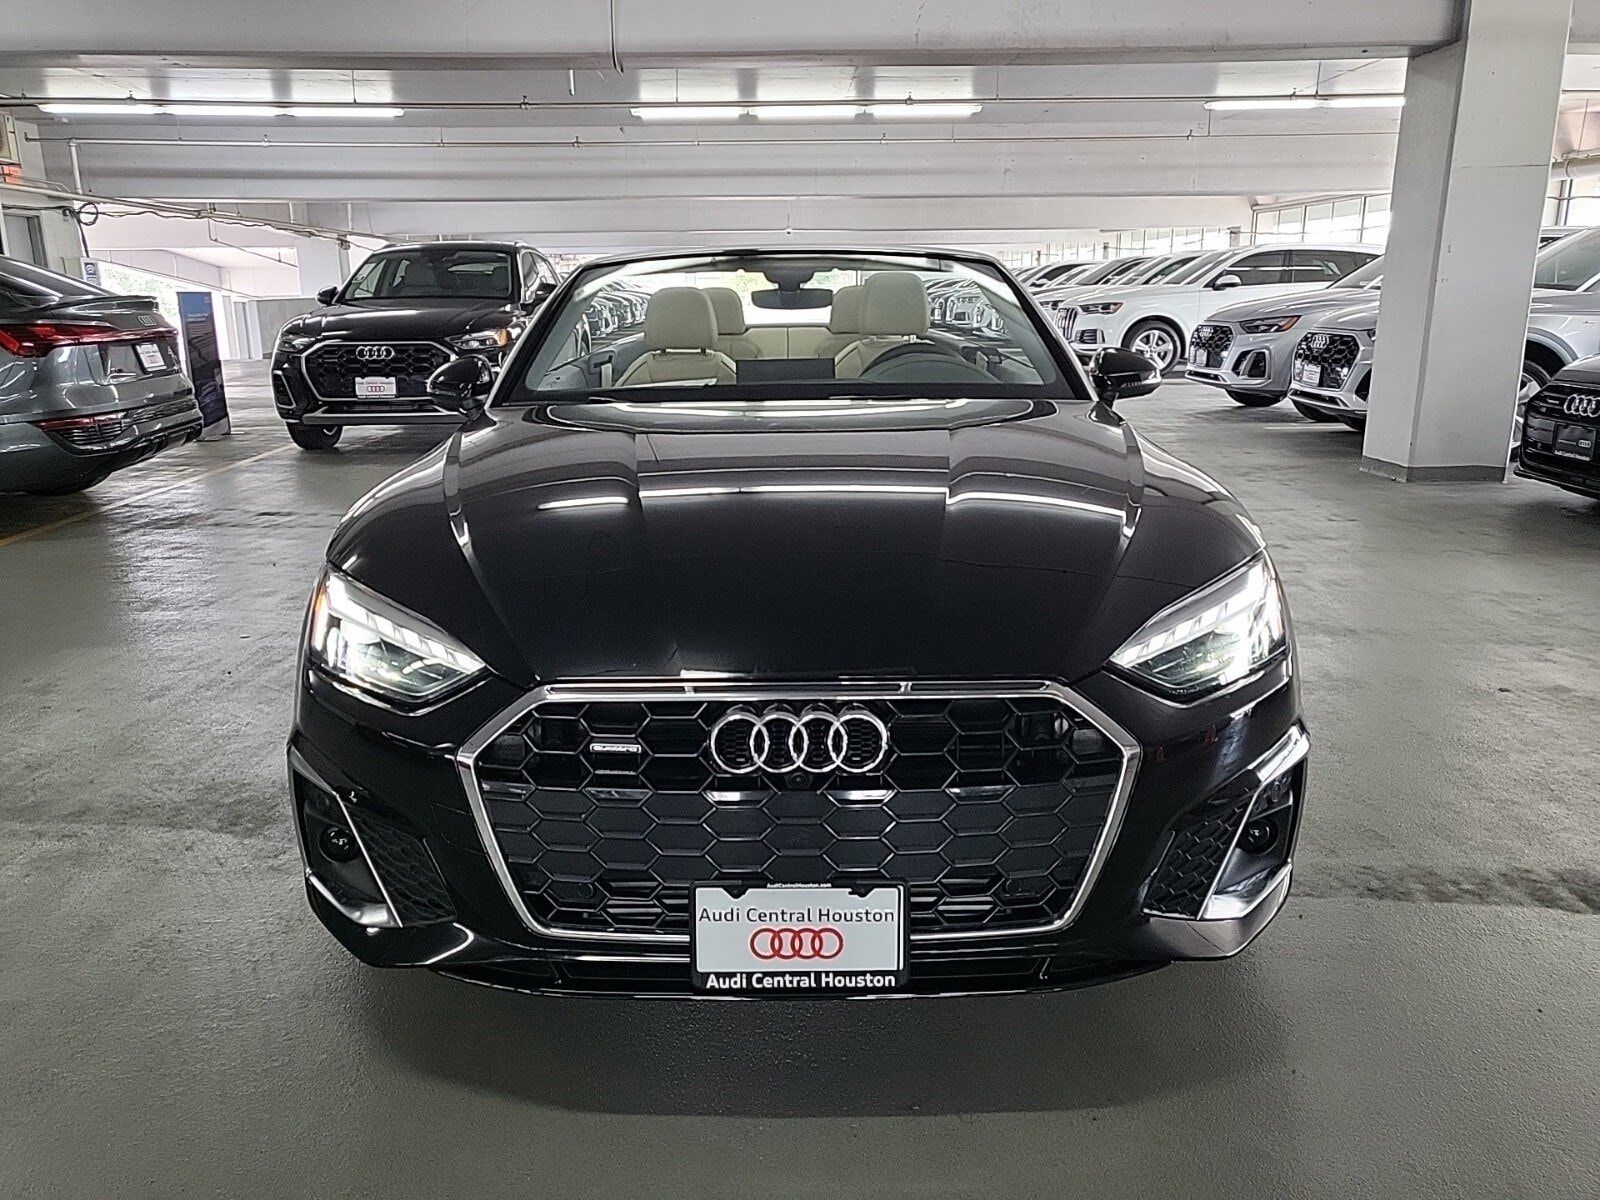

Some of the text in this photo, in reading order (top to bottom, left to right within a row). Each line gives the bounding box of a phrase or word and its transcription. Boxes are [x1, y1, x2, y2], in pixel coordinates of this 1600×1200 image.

[698, 907, 895, 923] Audi Central Houston
[706, 973, 896, 989] Audi Central Houston
